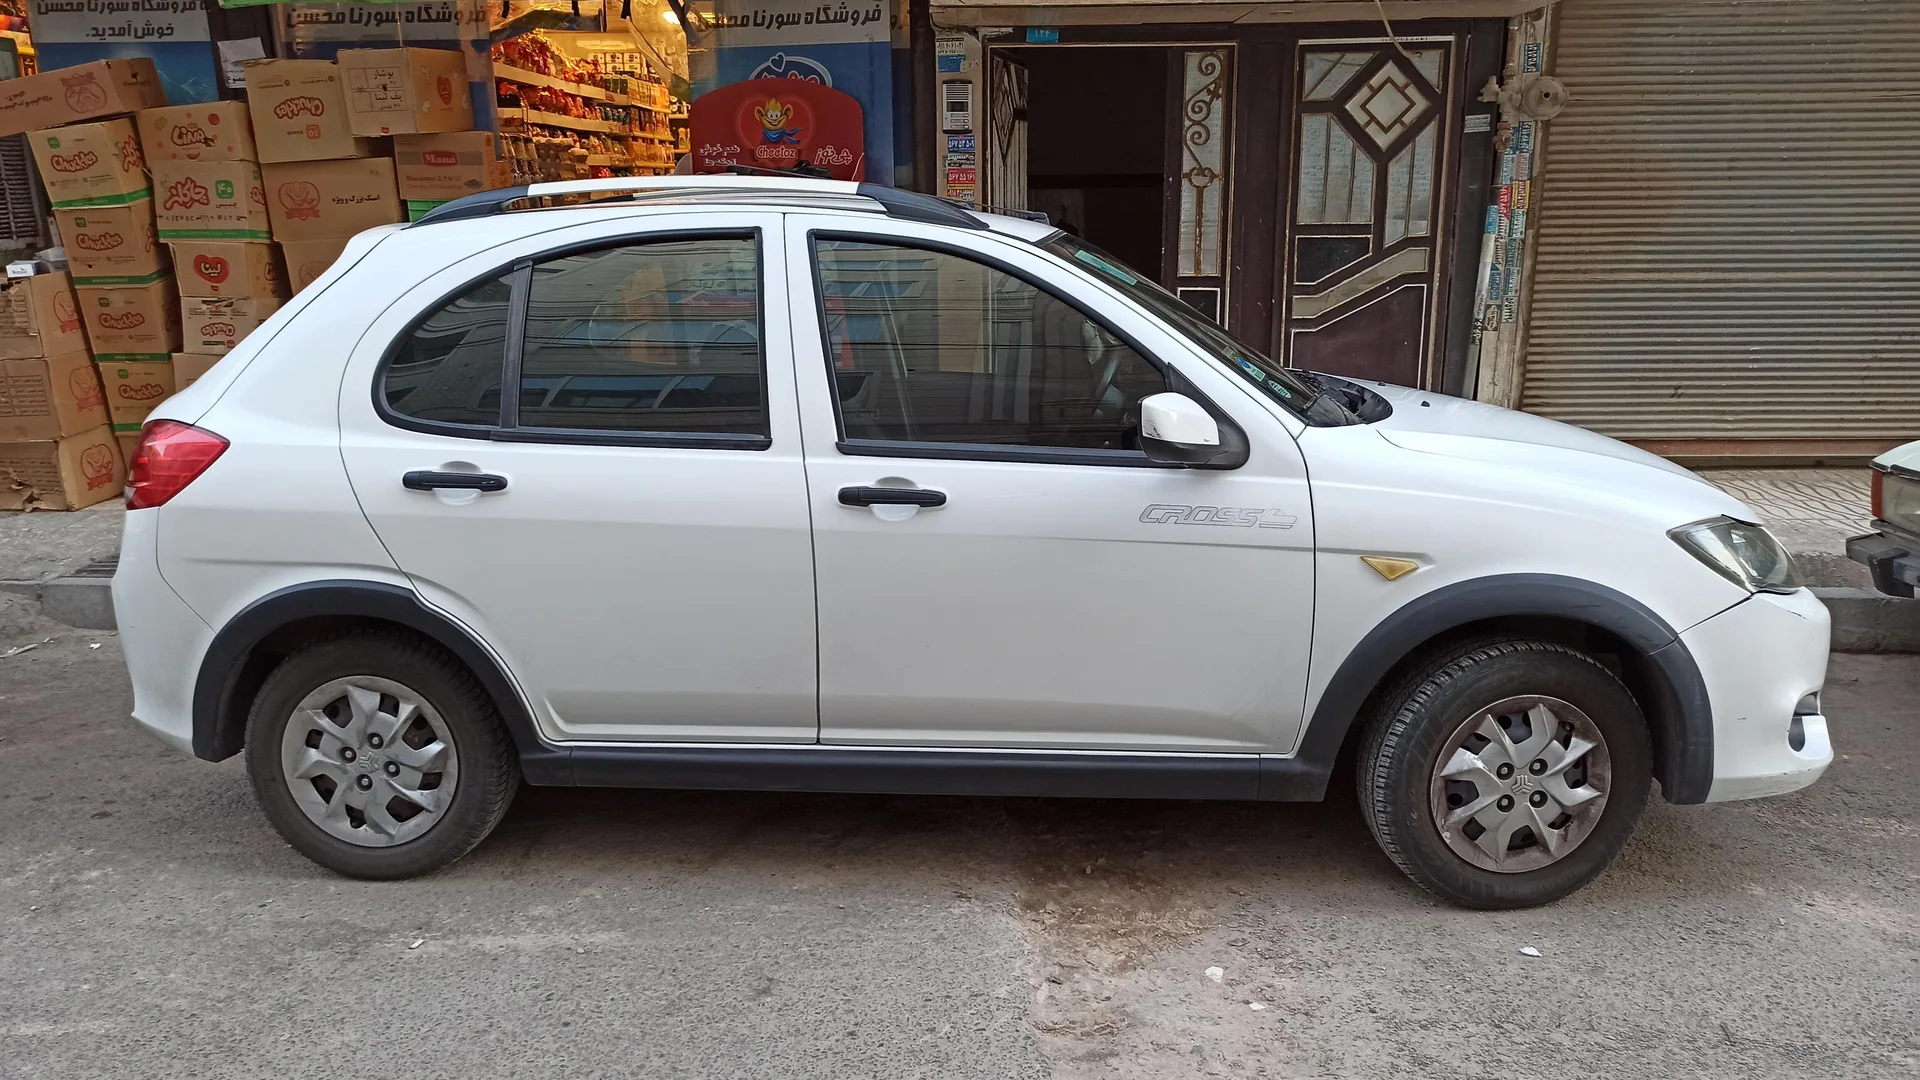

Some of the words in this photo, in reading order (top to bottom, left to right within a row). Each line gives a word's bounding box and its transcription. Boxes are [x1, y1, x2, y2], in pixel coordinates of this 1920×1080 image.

[349, 6, 402, 27] سورنا
[404, 2, 487, 26] فروشگاه
[752, 8, 801, 30] سورنا
[804, 2, 882, 27] فروشگاه
[134, 20, 175, 40] خوش
[273, 95, 325, 120] Chuckles
[50, 151, 99, 173] Chuckles
[756, 145, 797, 160] Cheetoz
[76, 232, 124, 252] Chuckles
[200, 262, 222, 277] لینا
[98, 312, 146, 330] Chuckles
[118, 383, 164, 401] Chuckles
[1139, 503, 1265, 528] CROSS
